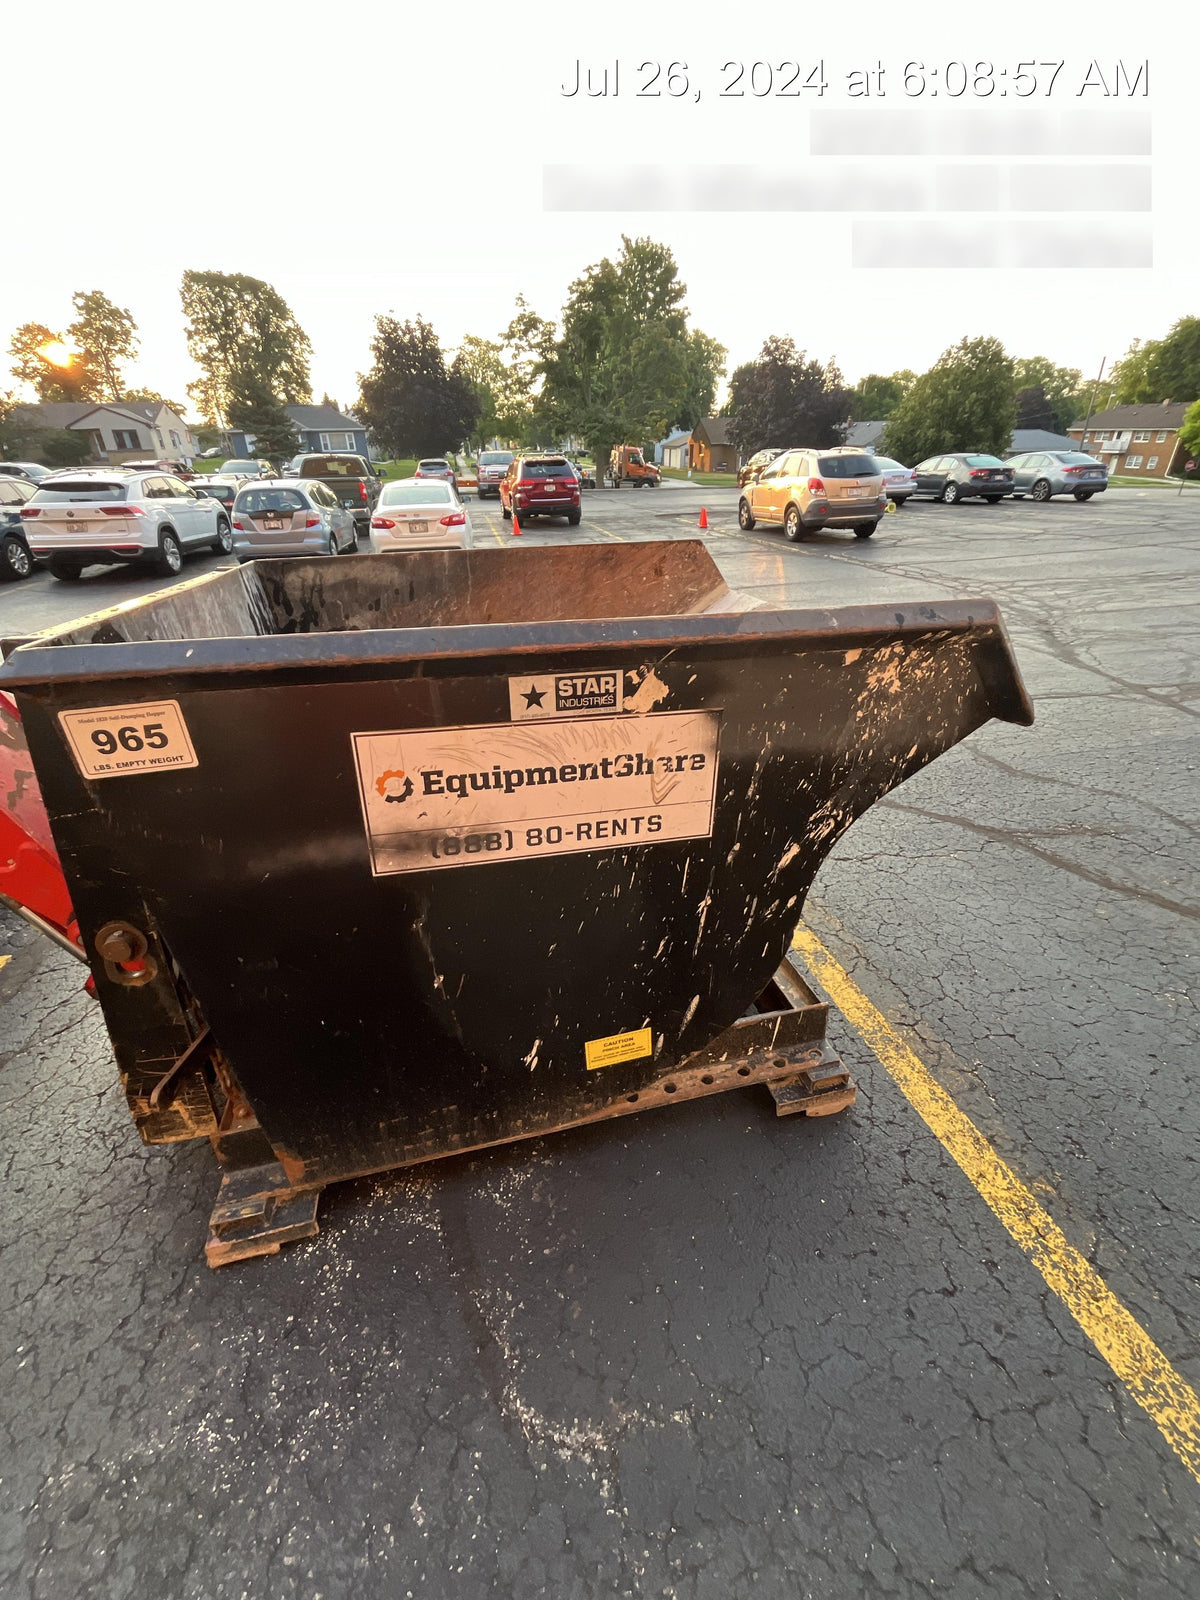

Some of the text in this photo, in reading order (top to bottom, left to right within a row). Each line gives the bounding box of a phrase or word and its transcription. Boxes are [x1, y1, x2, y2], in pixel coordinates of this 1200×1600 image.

[558, 676, 616, 696] STAR
[559, 695, 614, 708] INDUSTRIES
[90, 723, 169, 755] 965
[93, 755, 184, 772] LBS. EMPTY WEIGHT
[431, 814, 663, 859] (888) 80-RENTS
[603, 1037, 634, 1047] CAUTION
